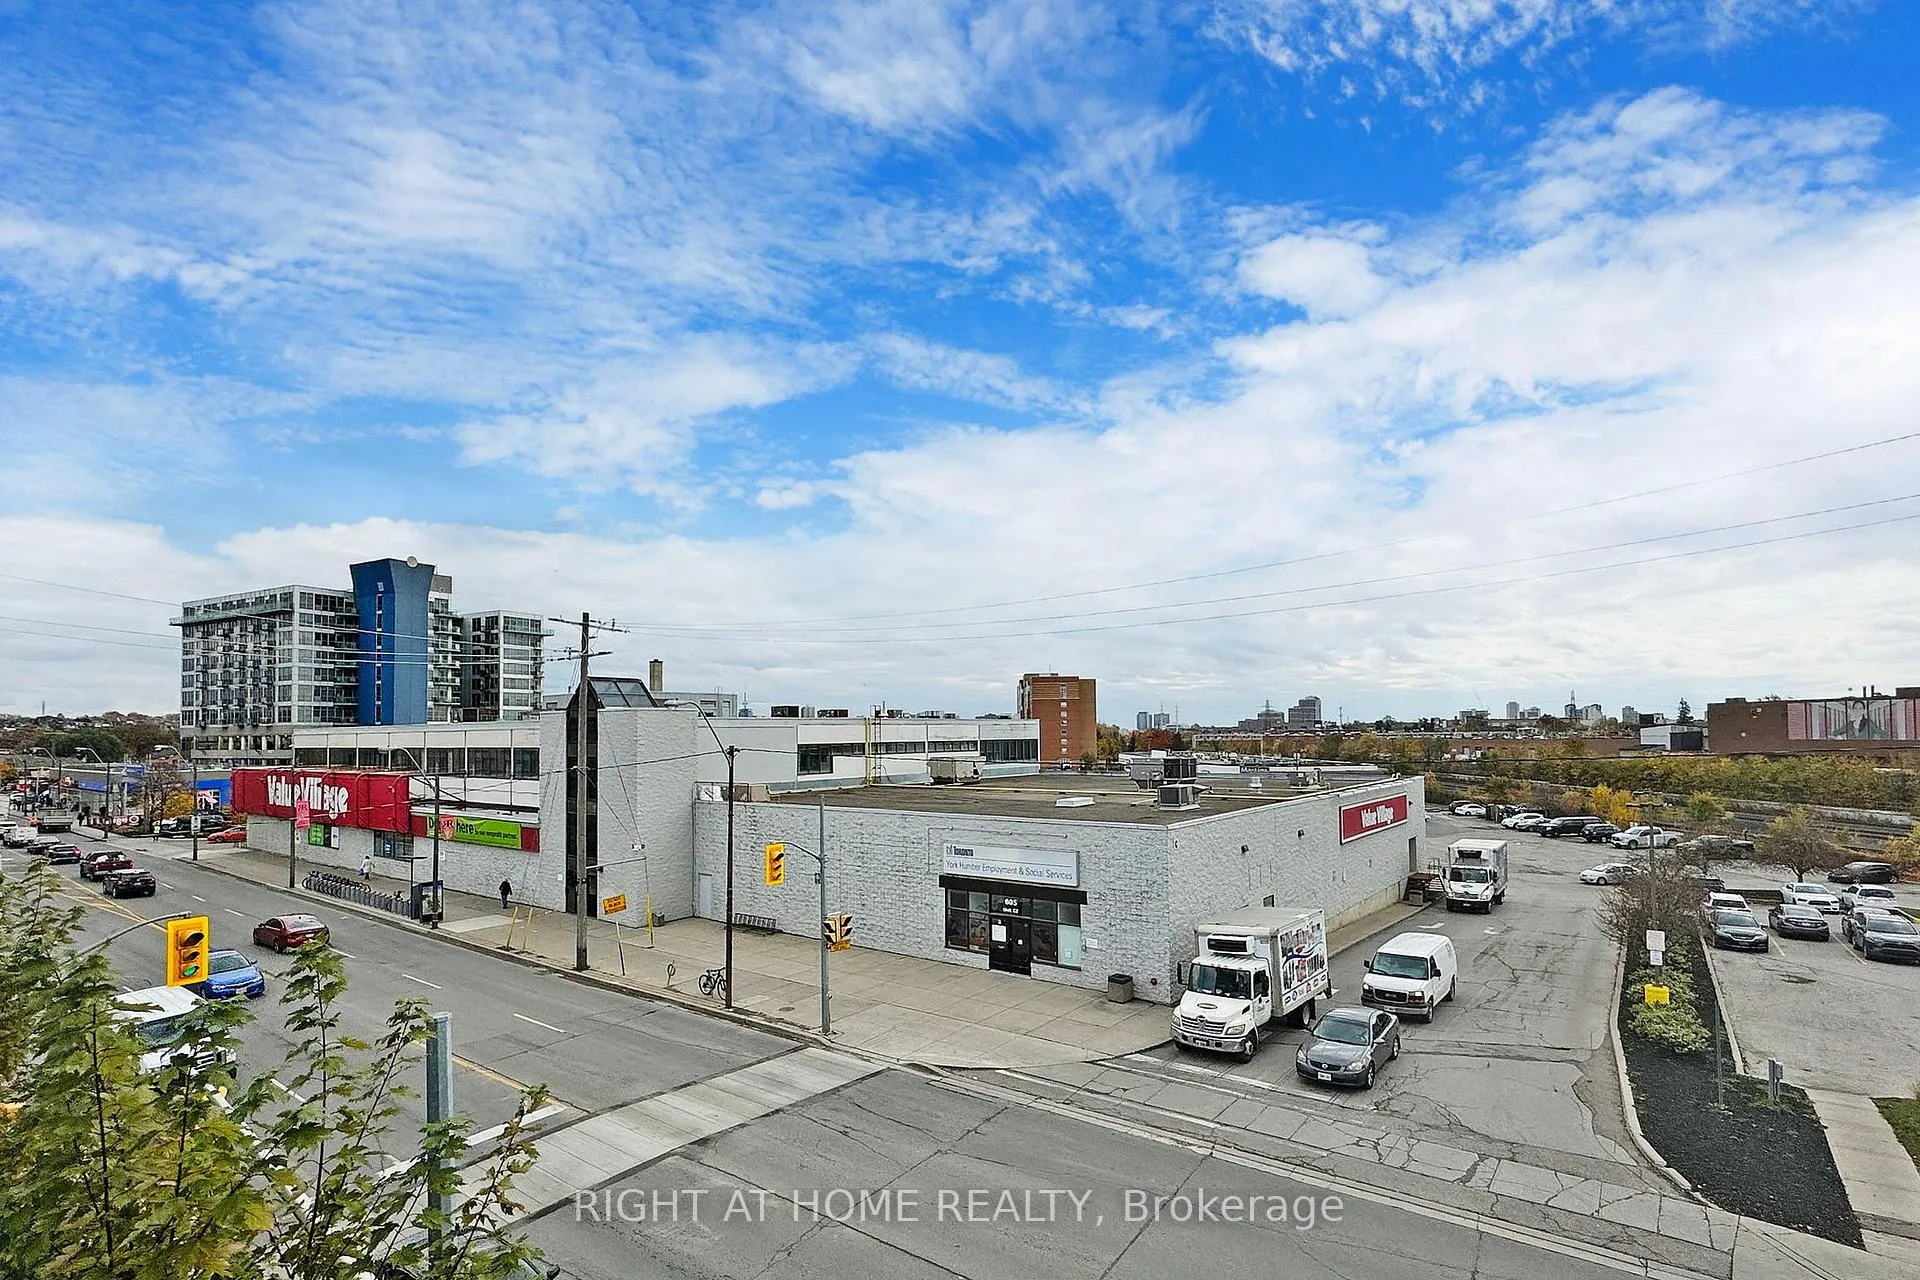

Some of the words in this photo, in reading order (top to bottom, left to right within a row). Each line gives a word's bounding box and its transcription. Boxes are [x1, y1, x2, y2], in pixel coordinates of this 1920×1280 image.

[267, 775, 301, 808] Value
[300, 777, 349, 820] Village
[456, 819, 474, 835] here
[1361, 808, 1376, 828] Value
[1376, 805, 1394, 825] Village
[946, 860, 958, 869] York
[959, 861, 980, 872] Humber
[982, 863, 1017, 875] Employment
[1019, 867, 1024, 875] &
[1026, 867, 1042, 878] Social
[1046, 869, 1072, 880] Services
